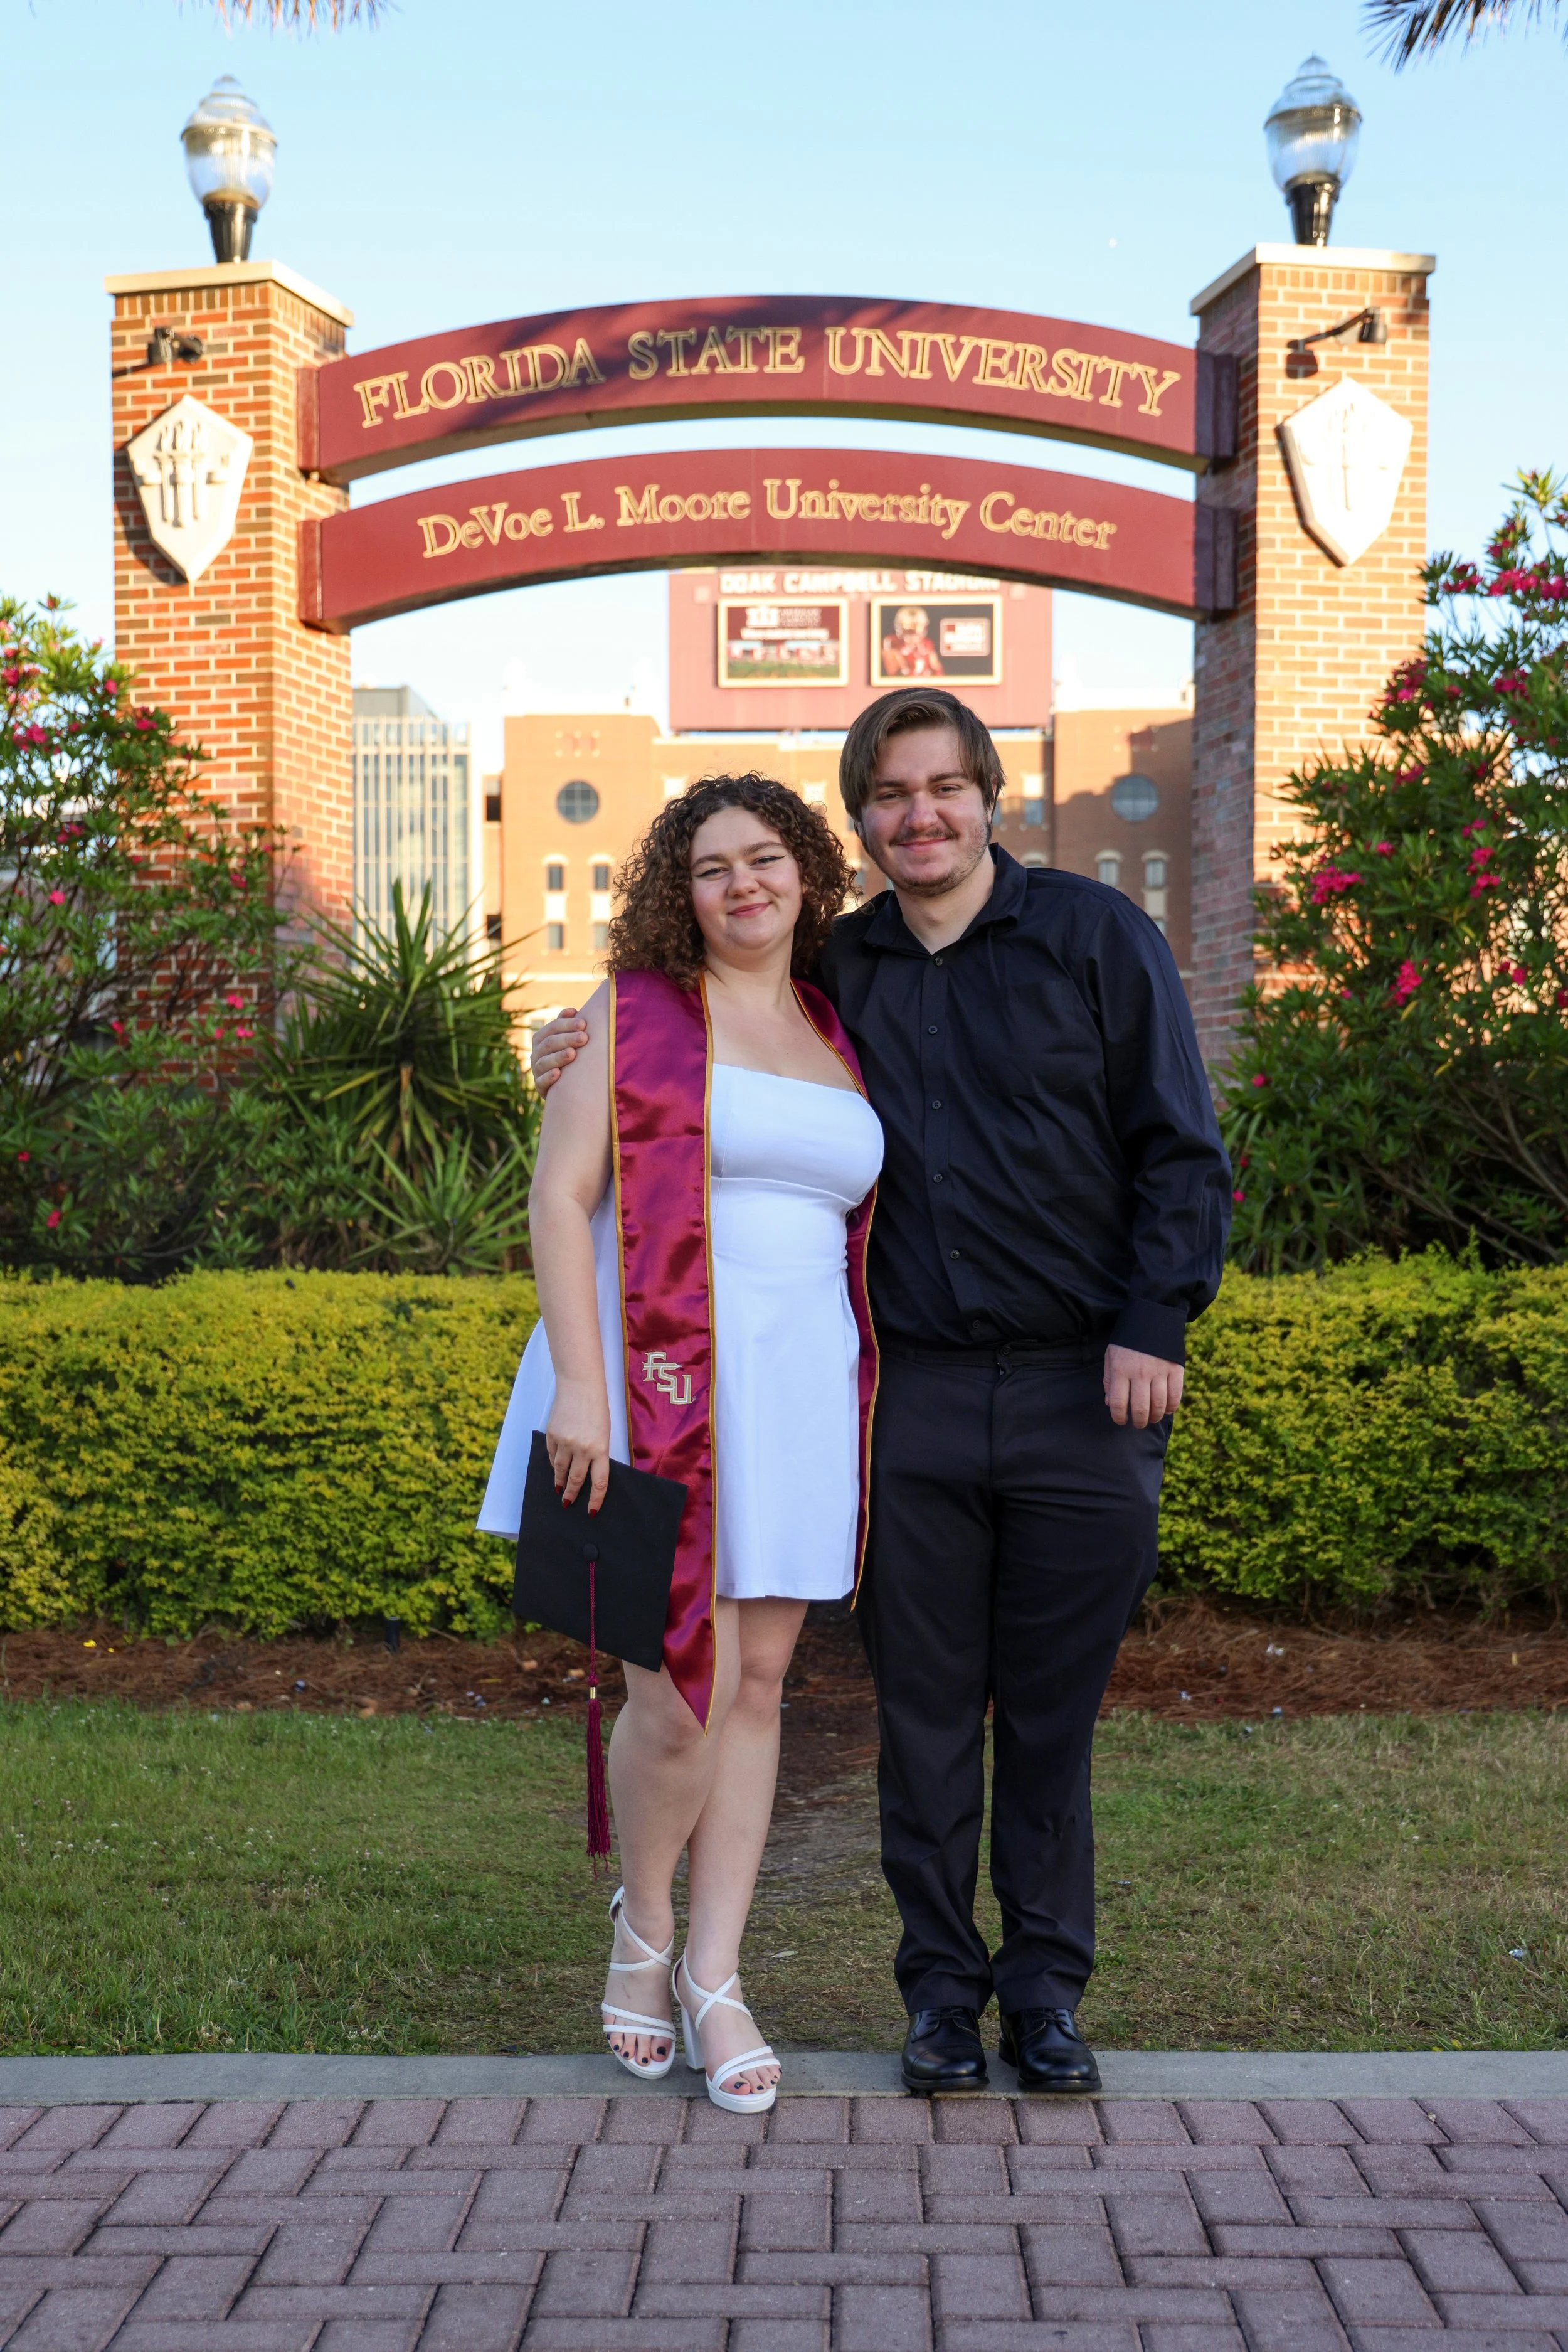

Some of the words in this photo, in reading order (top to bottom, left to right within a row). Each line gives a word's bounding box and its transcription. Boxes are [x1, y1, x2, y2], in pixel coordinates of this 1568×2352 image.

[353, 338, 606, 428] FLORIDA
[628, 325, 805, 380] STATE
[825, 327, 1180, 417] UNIVERSITY
[417, 501, 554, 558] DeVoe
[561, 491, 605, 533] L.
[614, 484, 751, 527] Moore
[762, 478, 970, 540] University
[979, 491, 1118, 550] Center
[720, 572, 776, 593] DOAK
[783, 572, 897, 593] CAMPBELL
[642, 1351, 692, 1404] FSU
